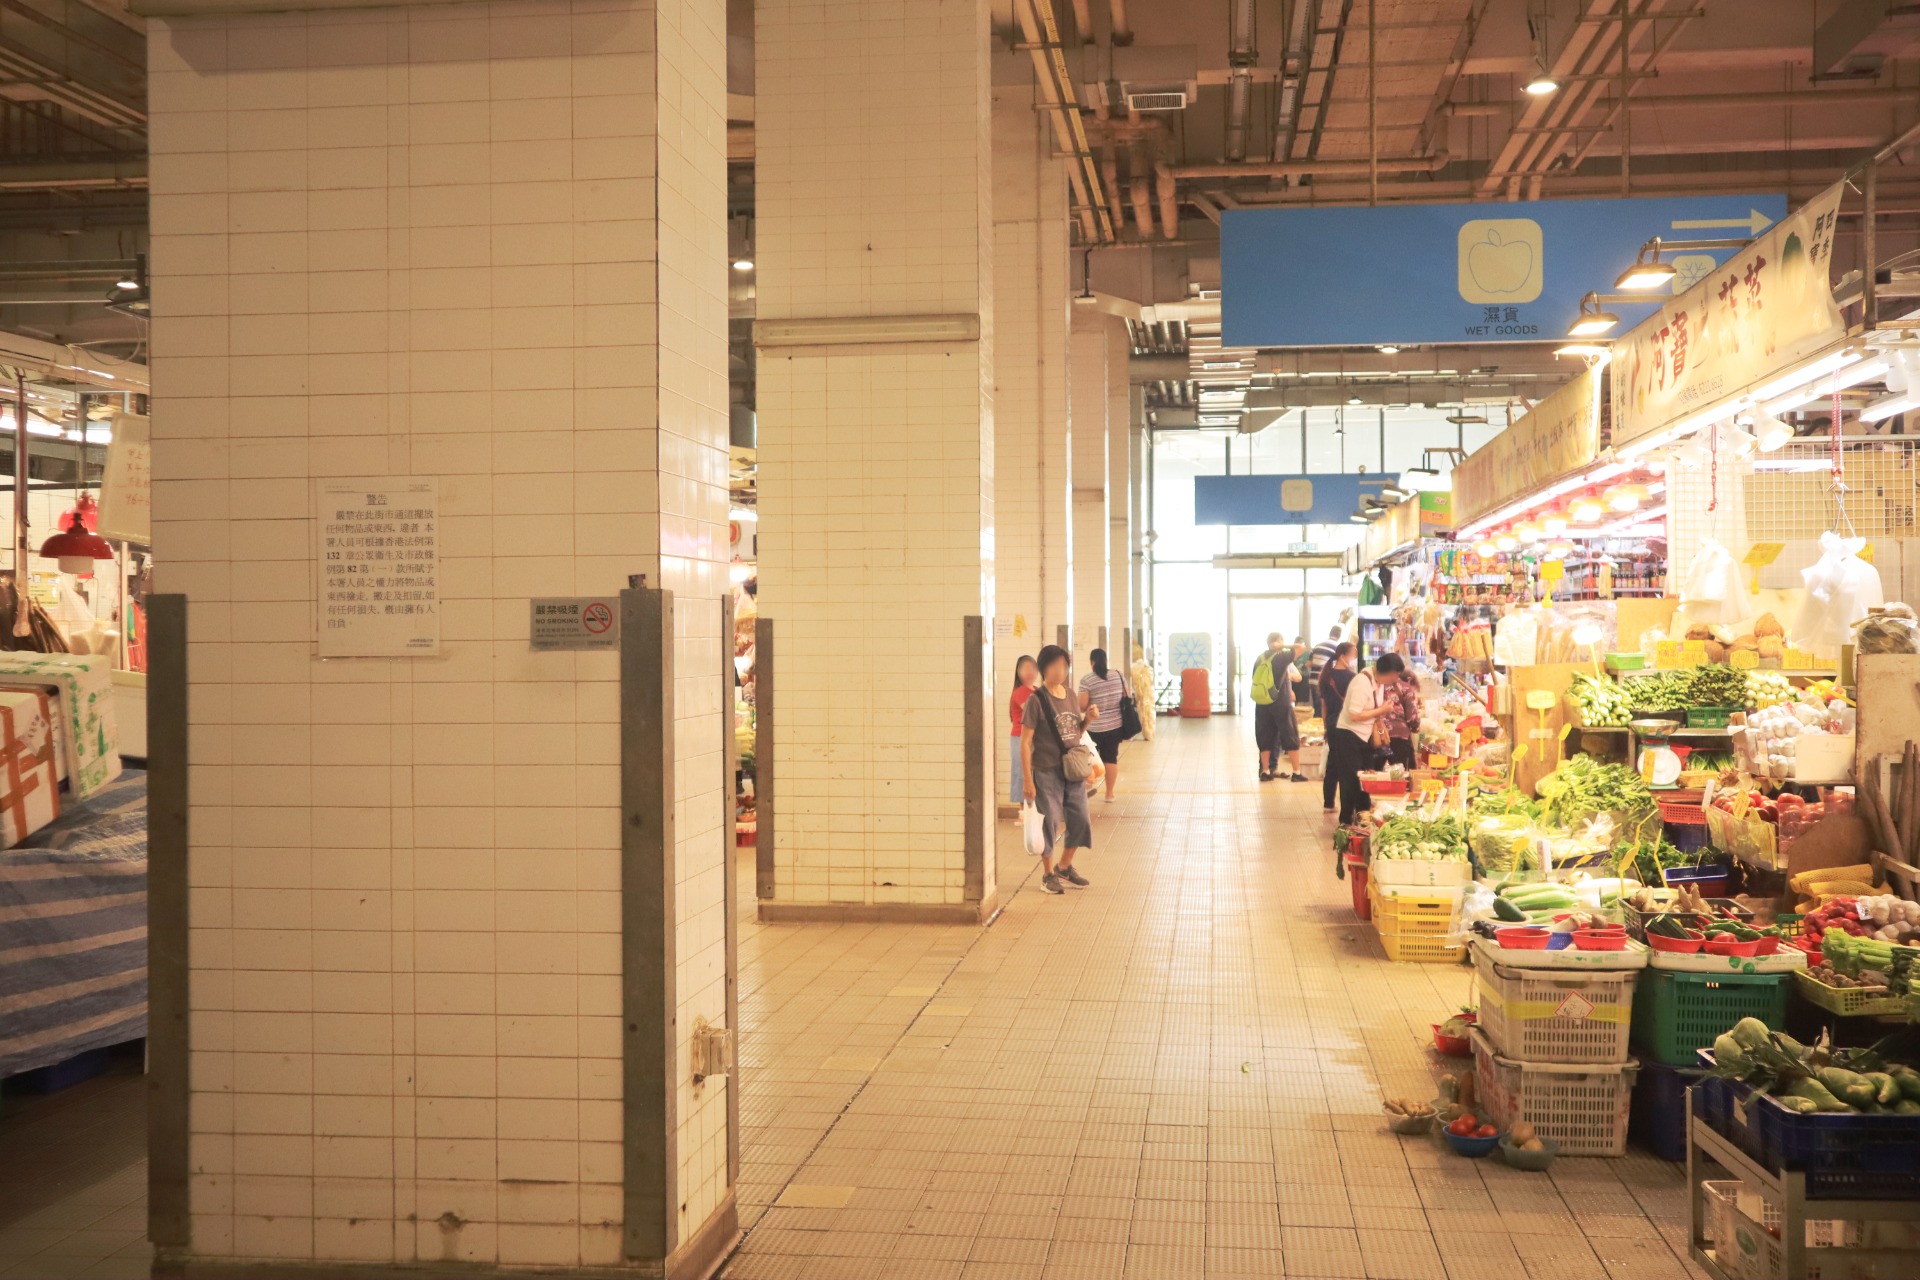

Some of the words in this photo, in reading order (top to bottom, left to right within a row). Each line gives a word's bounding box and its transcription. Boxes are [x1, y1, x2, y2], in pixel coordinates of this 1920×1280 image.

[1484, 306, 1519, 323] 濕貨
[1465, 325, 1490, 335] WET
[1495, 325, 1538, 335] GOODS
[535, 604, 579, 615] 嚴禁吸煙
